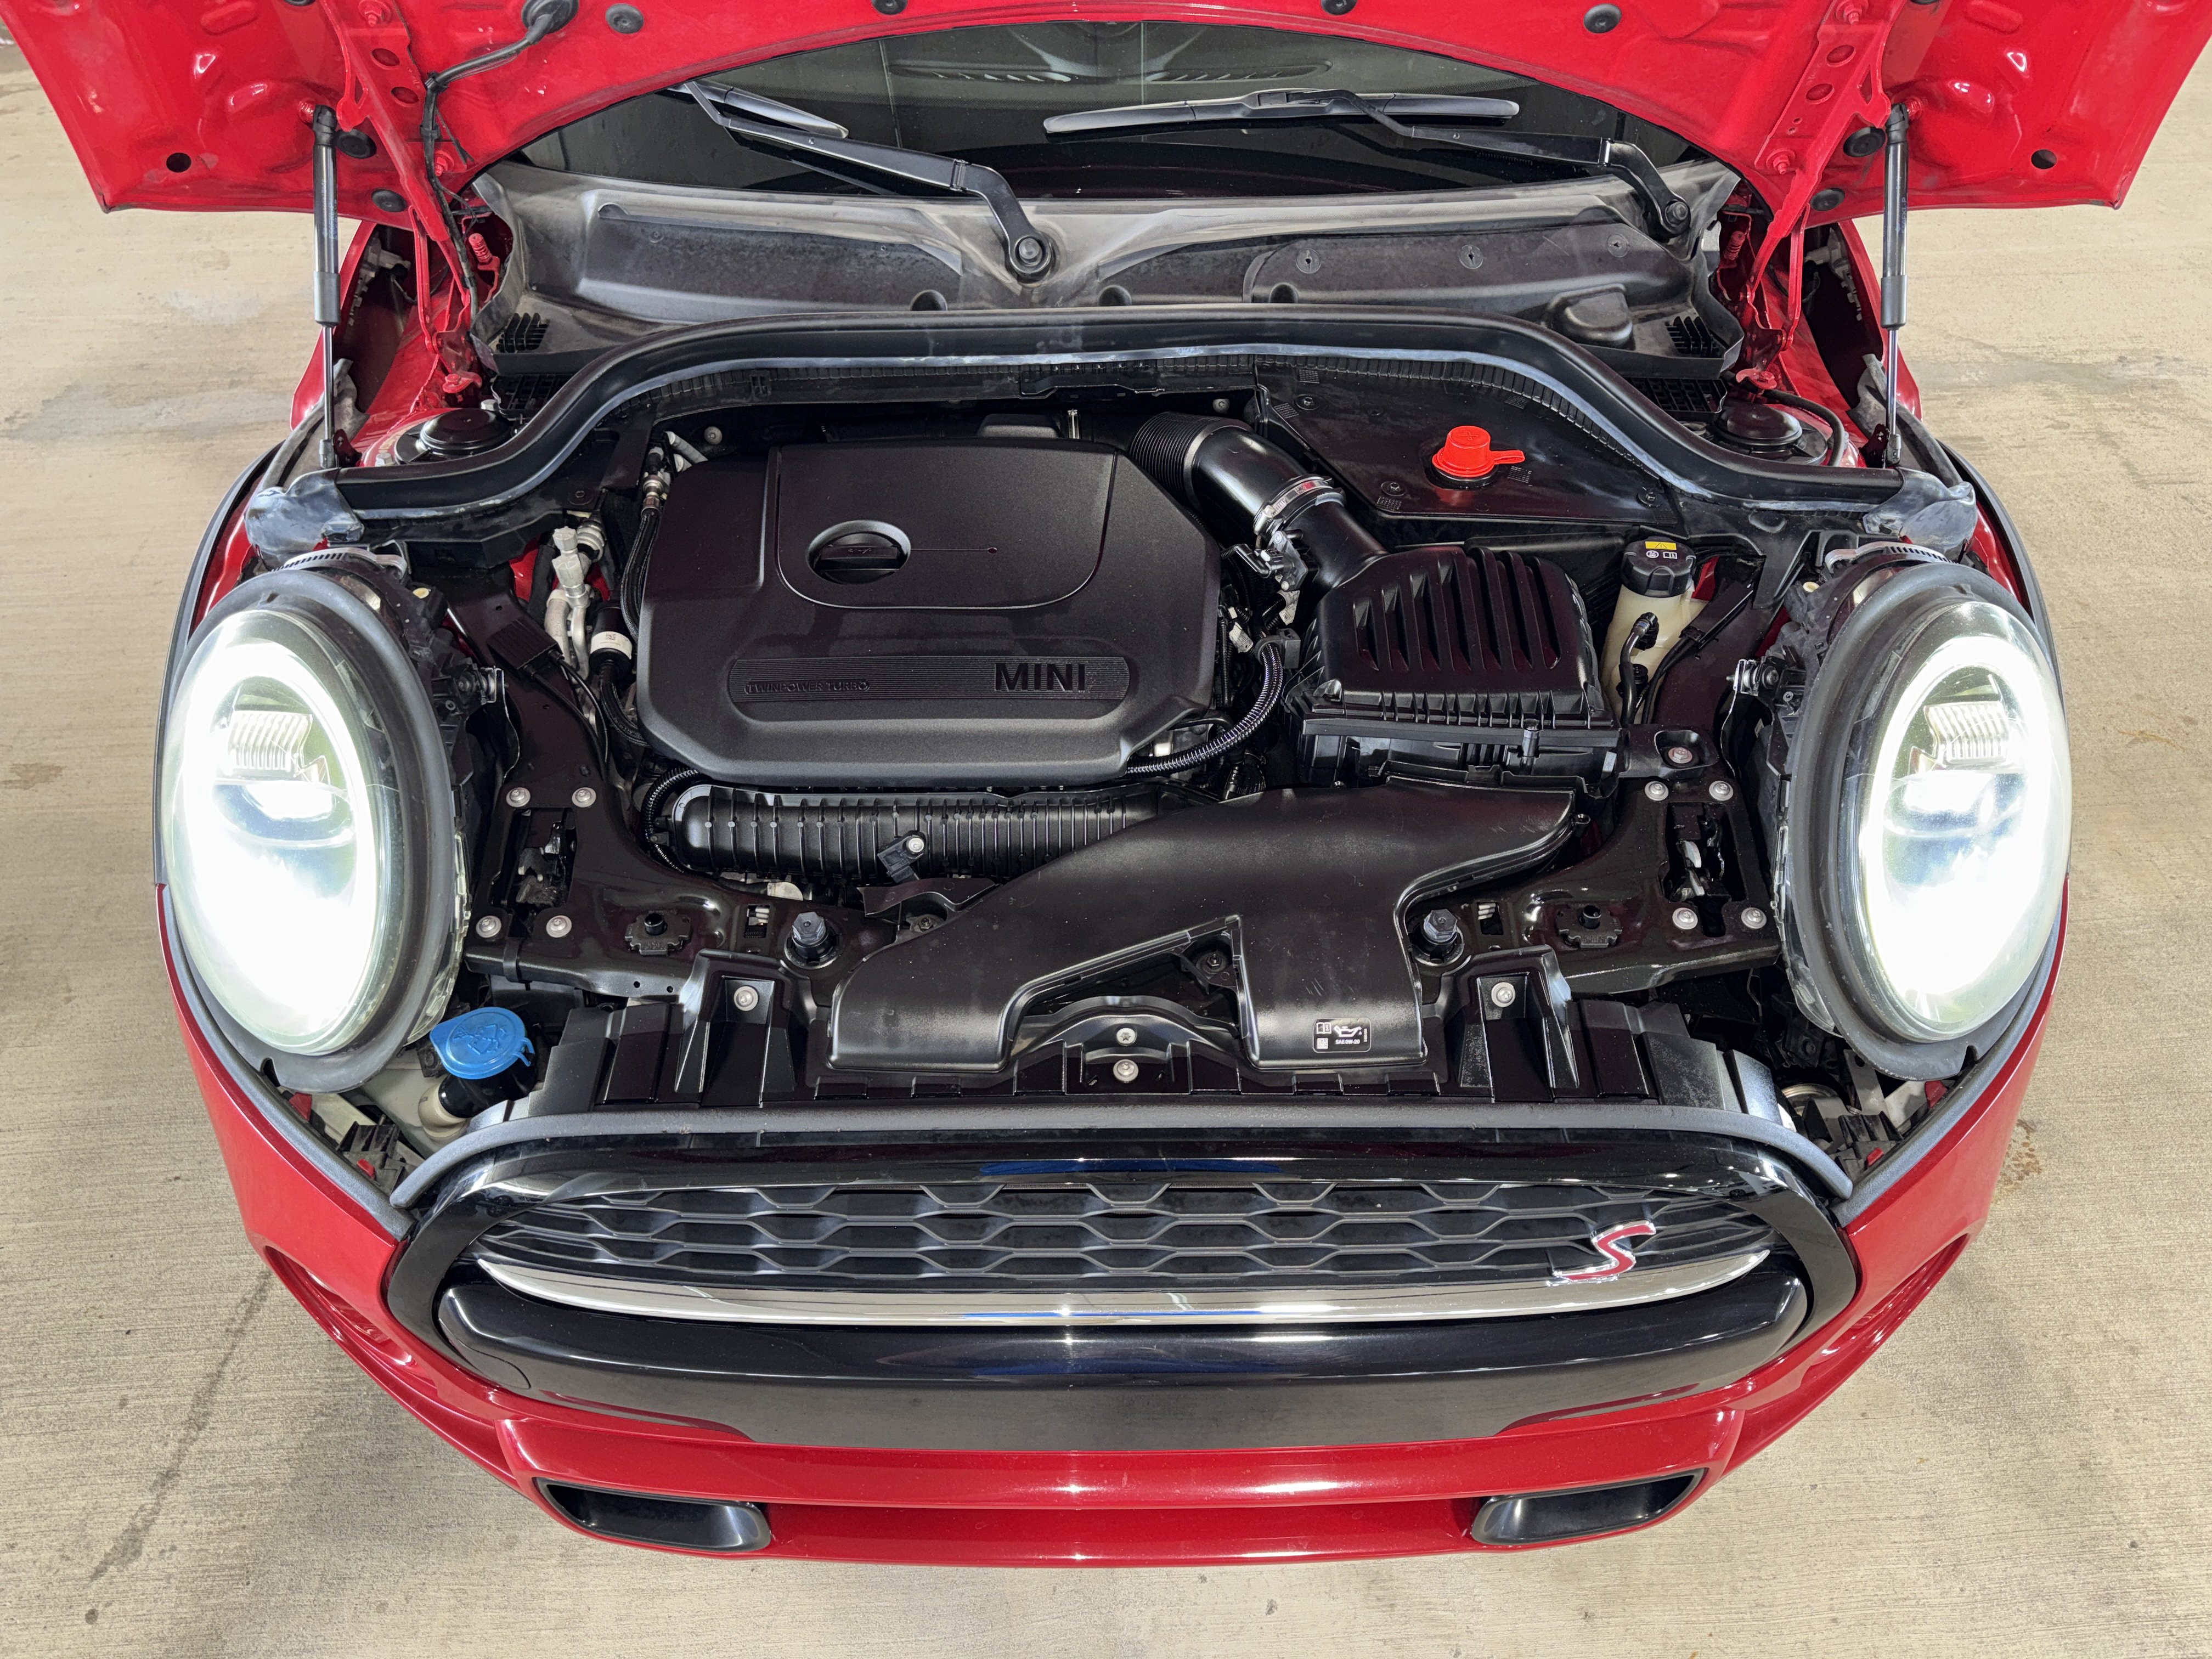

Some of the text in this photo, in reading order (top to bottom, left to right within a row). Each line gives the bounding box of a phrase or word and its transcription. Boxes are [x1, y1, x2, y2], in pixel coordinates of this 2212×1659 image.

[747, 681, 868, 693] TWINPOWER TURBO
[996, 663, 1085, 692] MINI
[1551, 1219, 1656, 1283] S
